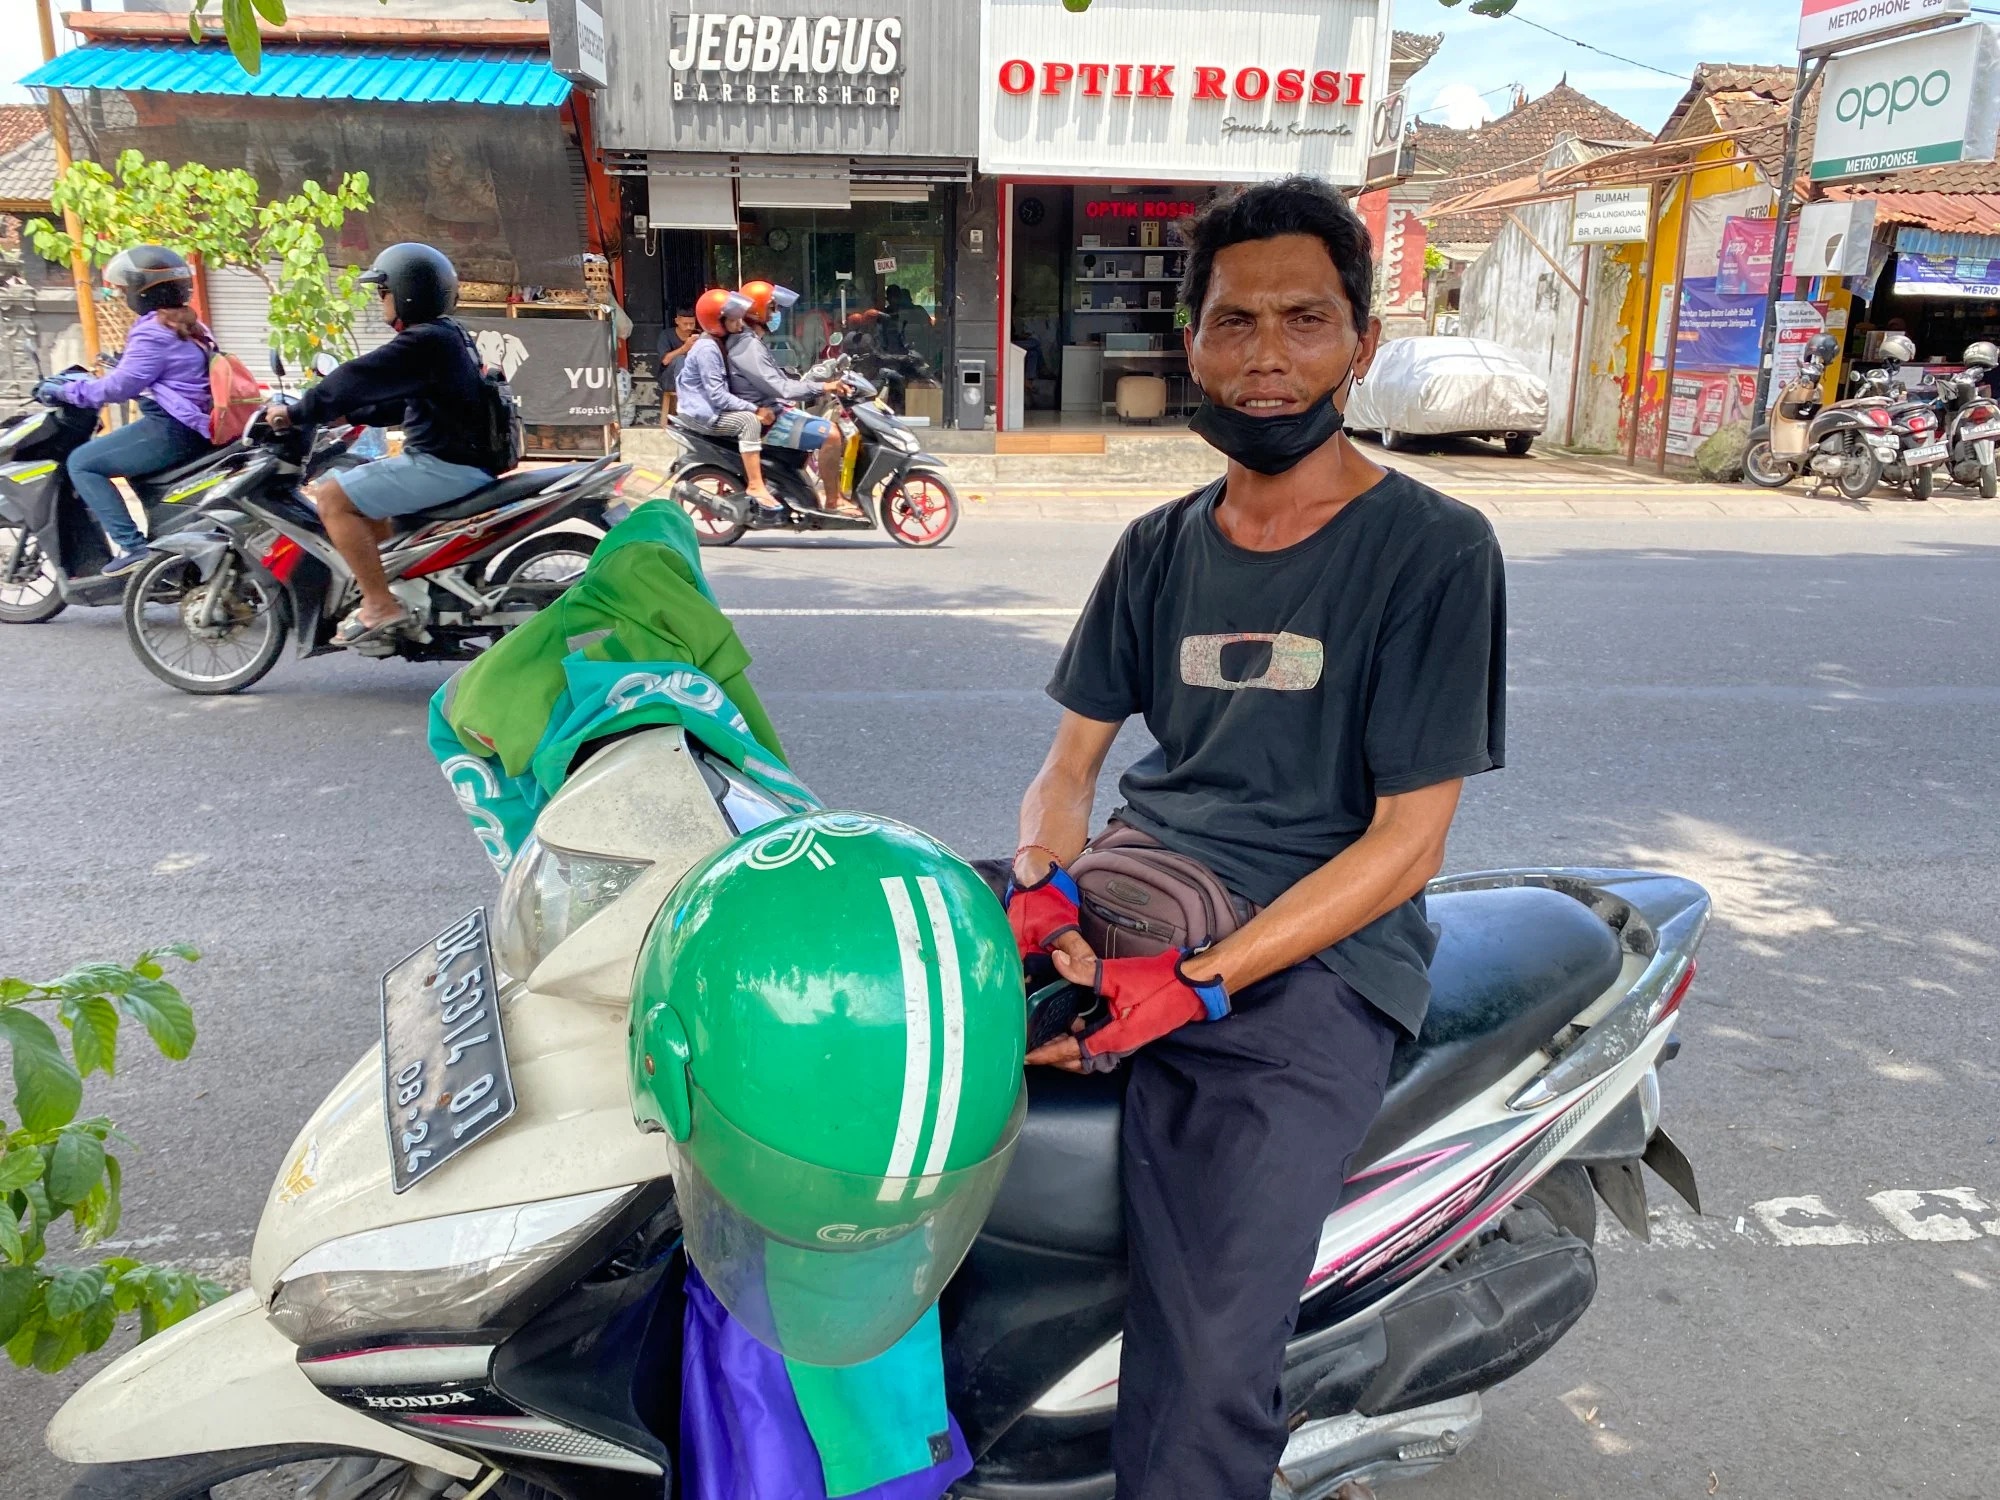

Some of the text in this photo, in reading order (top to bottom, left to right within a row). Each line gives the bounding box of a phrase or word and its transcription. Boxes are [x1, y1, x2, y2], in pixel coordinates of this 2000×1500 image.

[1828, 0, 1911, 30] METRO PHONE
[669, 13, 901, 75] JEGBAGUS
[998, 59, 1365, 106] OPTIK ROSSI
[673, 81, 900, 106] BARBERSHOP
[1836, 69, 1951, 130] oppo
[1845, 150, 1919, 173] METRO PONSEL
[1594, 192, 1630, 203] RUMAH
[1086, 201, 1138, 218] OPTIK
[1576, 209, 1647, 219] KEPALA LINGKUNGAN
[1744, 204, 1769, 219] METRO
[1578, 225, 1642, 236] BR. PURI AGUNG
[876, 260, 895, 271] BUKA
[1962, 284, 1999, 296] METRO
[436, 912, 482, 974] DK
[440, 964, 490, 1066] 5314
[363, 1391, 476, 1408] HONDA
